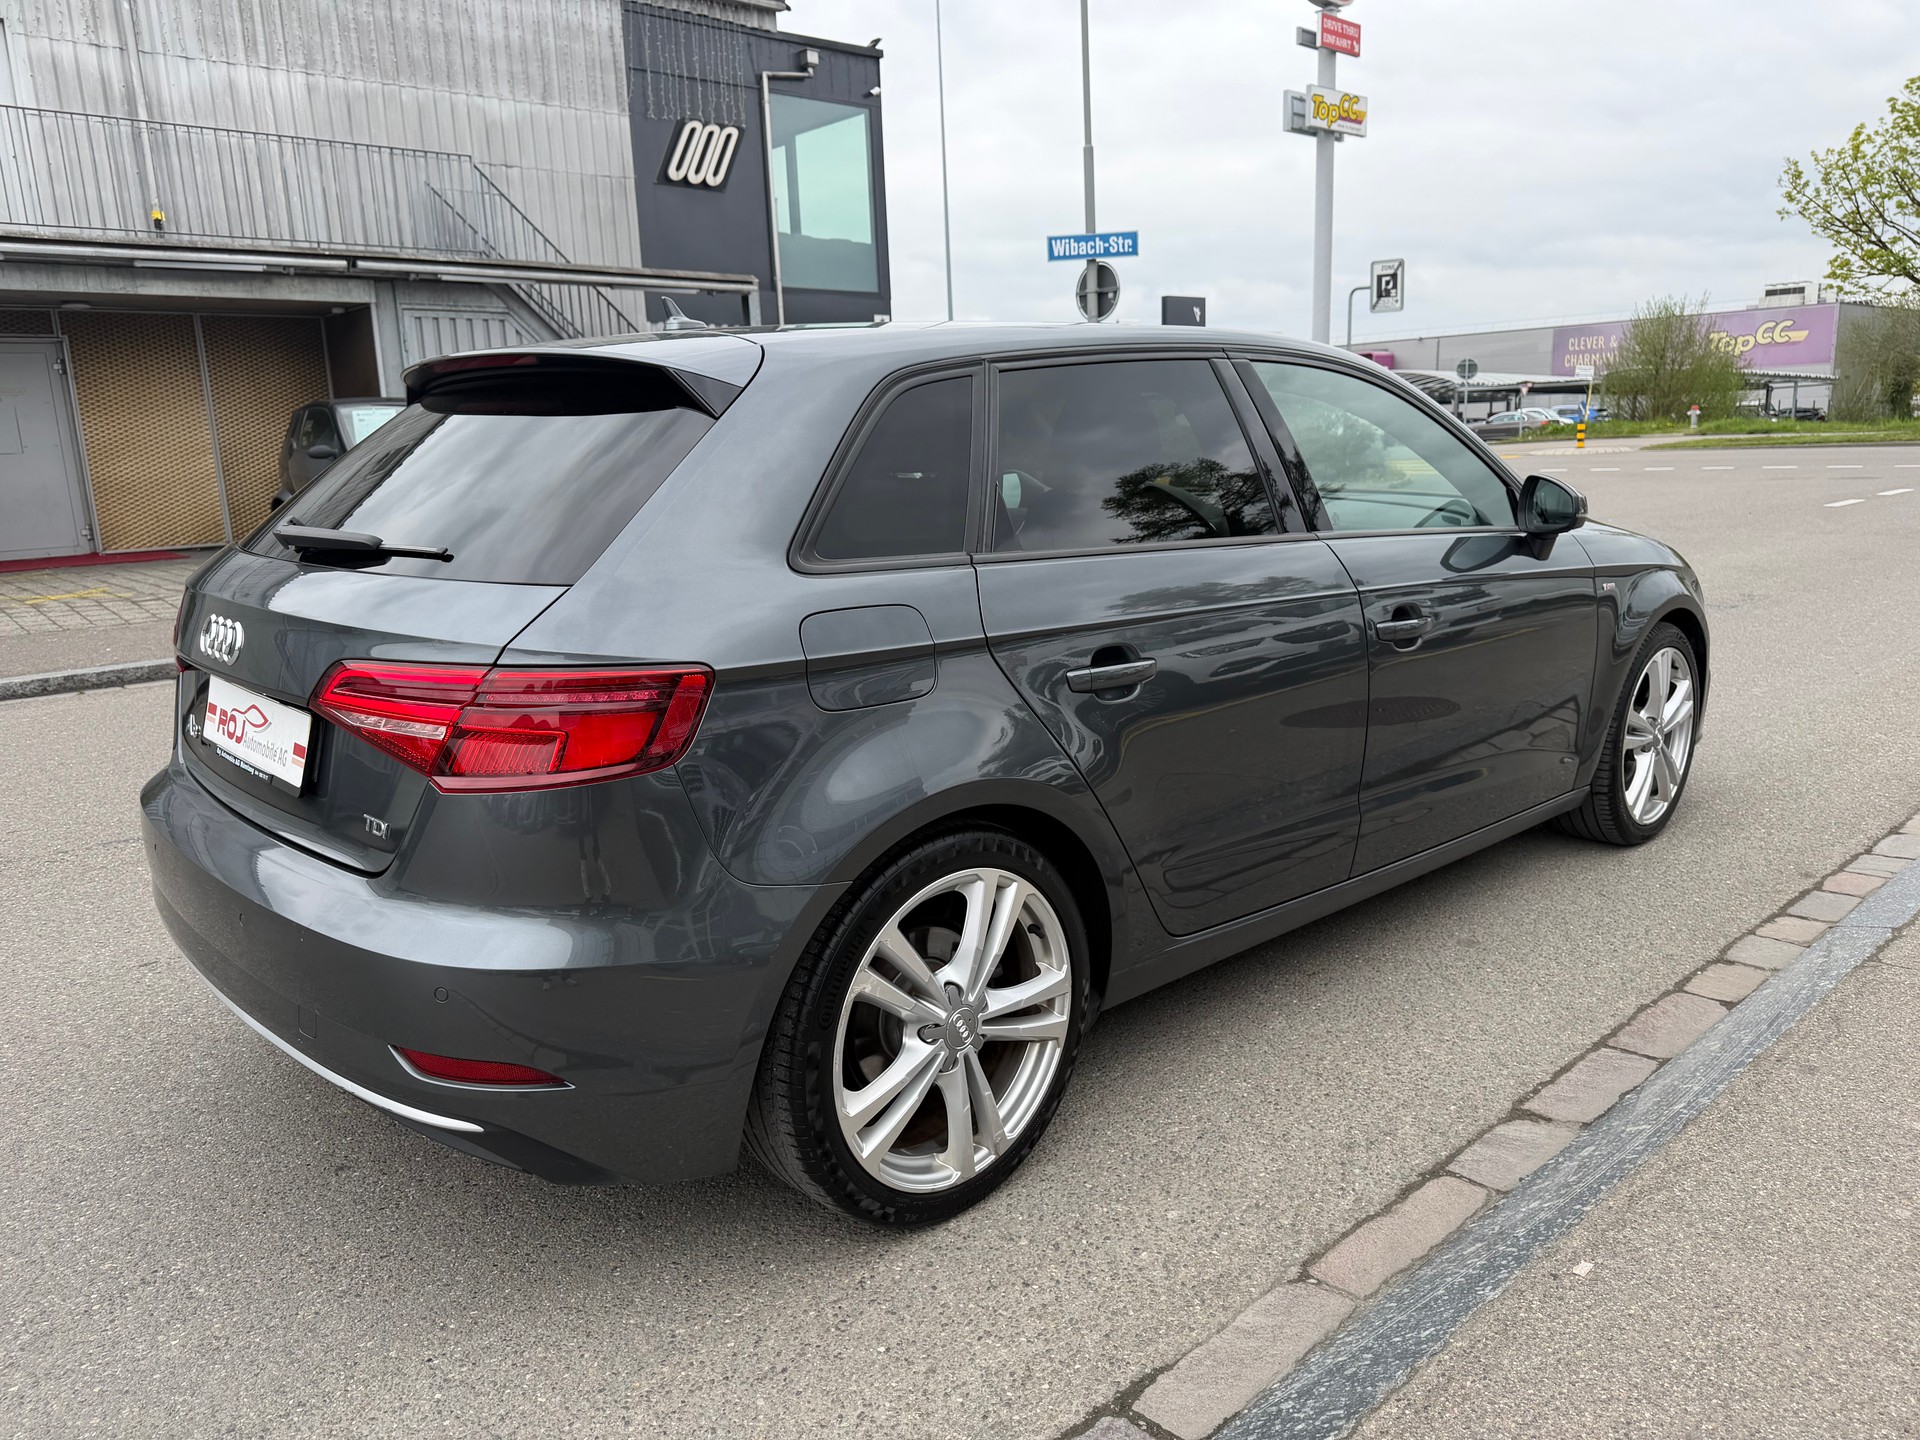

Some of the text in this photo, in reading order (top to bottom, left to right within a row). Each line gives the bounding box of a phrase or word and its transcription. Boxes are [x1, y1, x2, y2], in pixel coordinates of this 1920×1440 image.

[1323, 18, 1359, 38] DRIVE THRU
[1323, 32, 1352, 49] EINFAHRT
[1311, 93, 1359, 128] TopCC
[1051, 236, 1133, 257] Wibach-Str.
[1568, 334, 1618, 351] CLEVER &
[1709, 319, 1795, 356] TopCC
[217, 708, 247, 744] ROJ
[242, 731, 288, 767] Automobile AG
[363, 813, 391, 840] TDI
